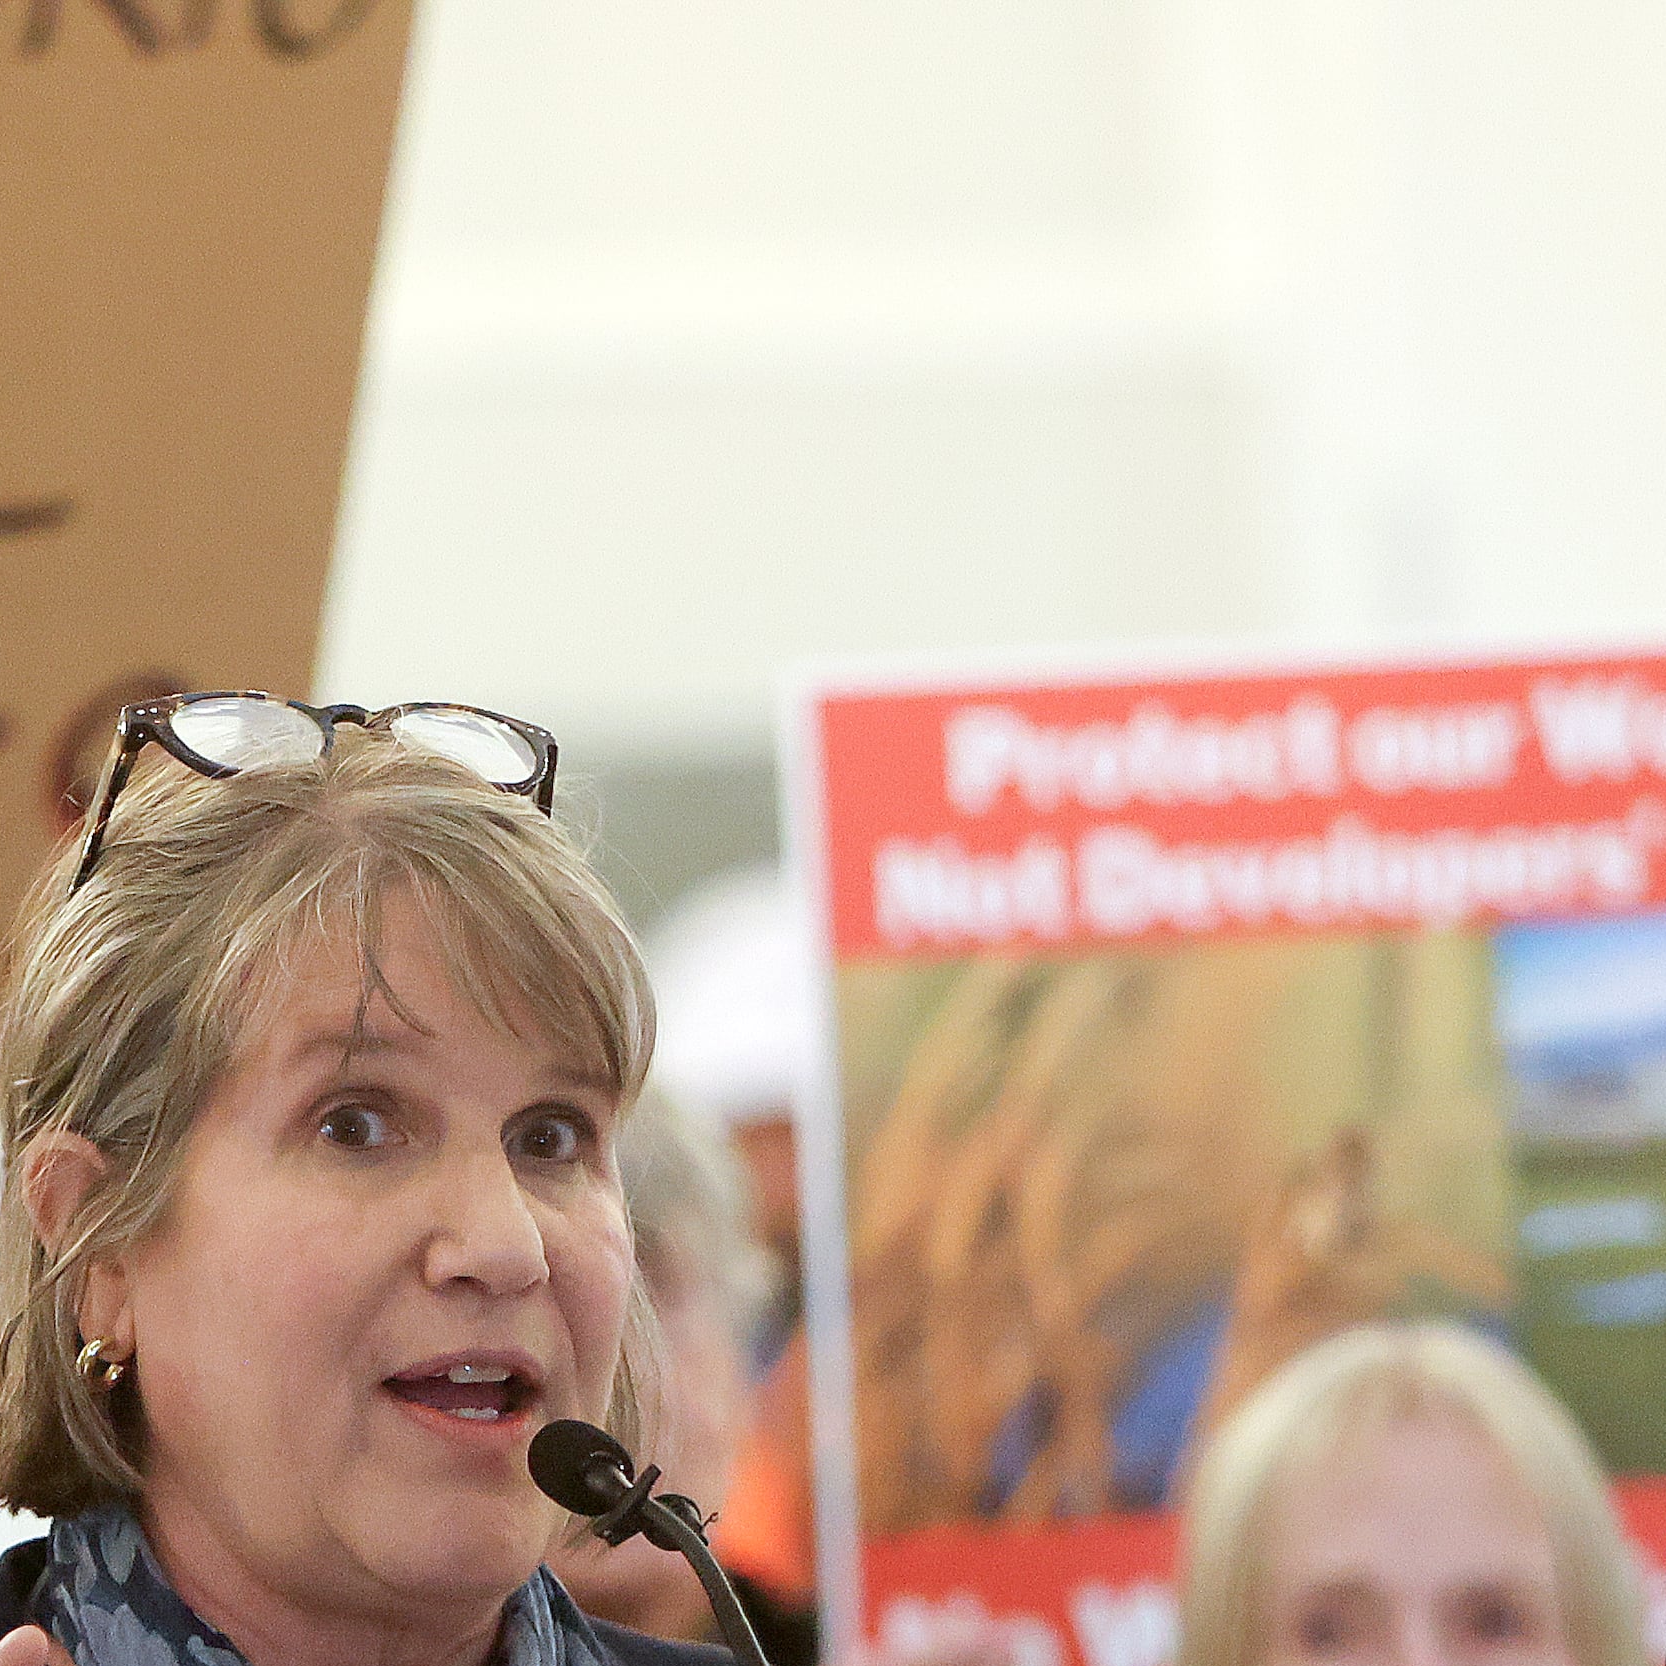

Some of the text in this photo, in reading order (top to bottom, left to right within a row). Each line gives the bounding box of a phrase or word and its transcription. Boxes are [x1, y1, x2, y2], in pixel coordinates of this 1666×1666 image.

[941, 688, 1337, 818] Protect
[1343, 698, 1519, 796] our
[873, 828, 1071, 950] Not
